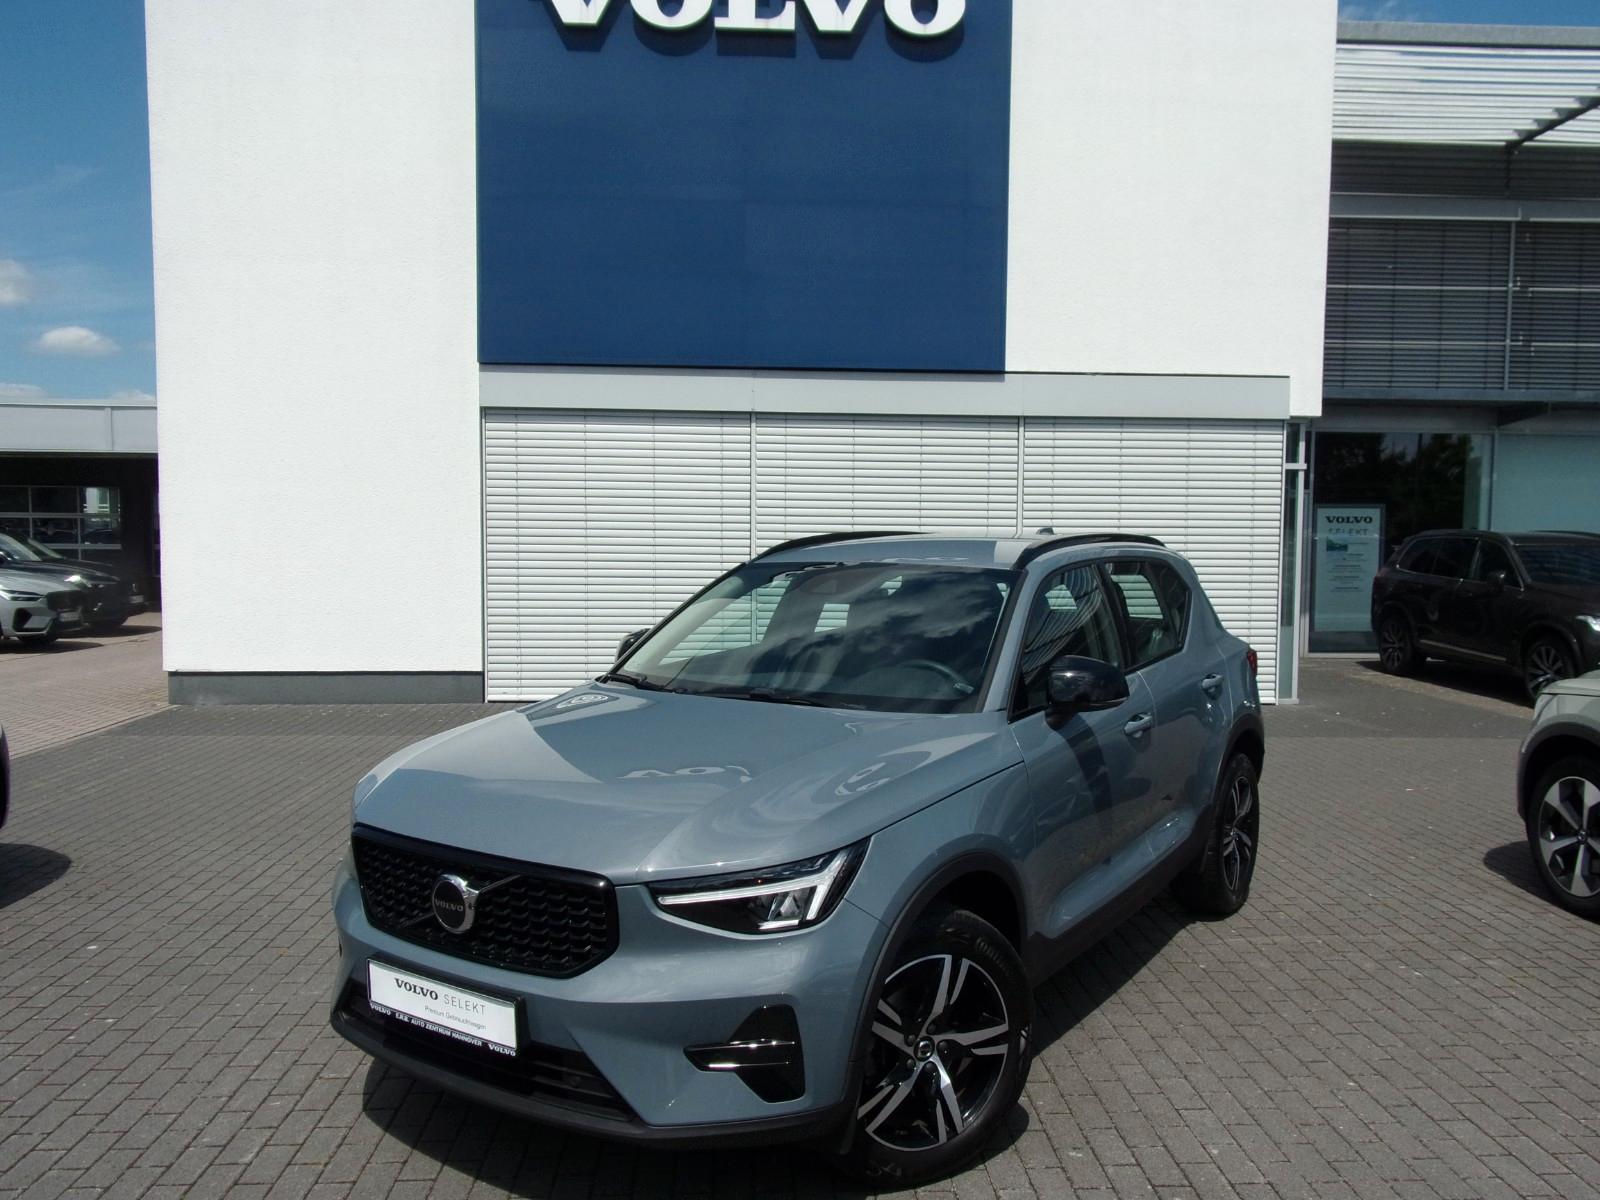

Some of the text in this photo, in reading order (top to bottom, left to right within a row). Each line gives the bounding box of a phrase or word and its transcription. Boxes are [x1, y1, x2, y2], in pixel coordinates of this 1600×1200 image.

[1325, 515, 1373, 524] VOLVO
[435, 899, 464, 912] VOLVO
[394, 977, 487, 1015] VOLVO SELEKT
[370, 1003, 392, 1016] VOLVO
[451, 1030, 483, 1047] HANNOVER
[487, 1043, 516, 1057] VOLVO
